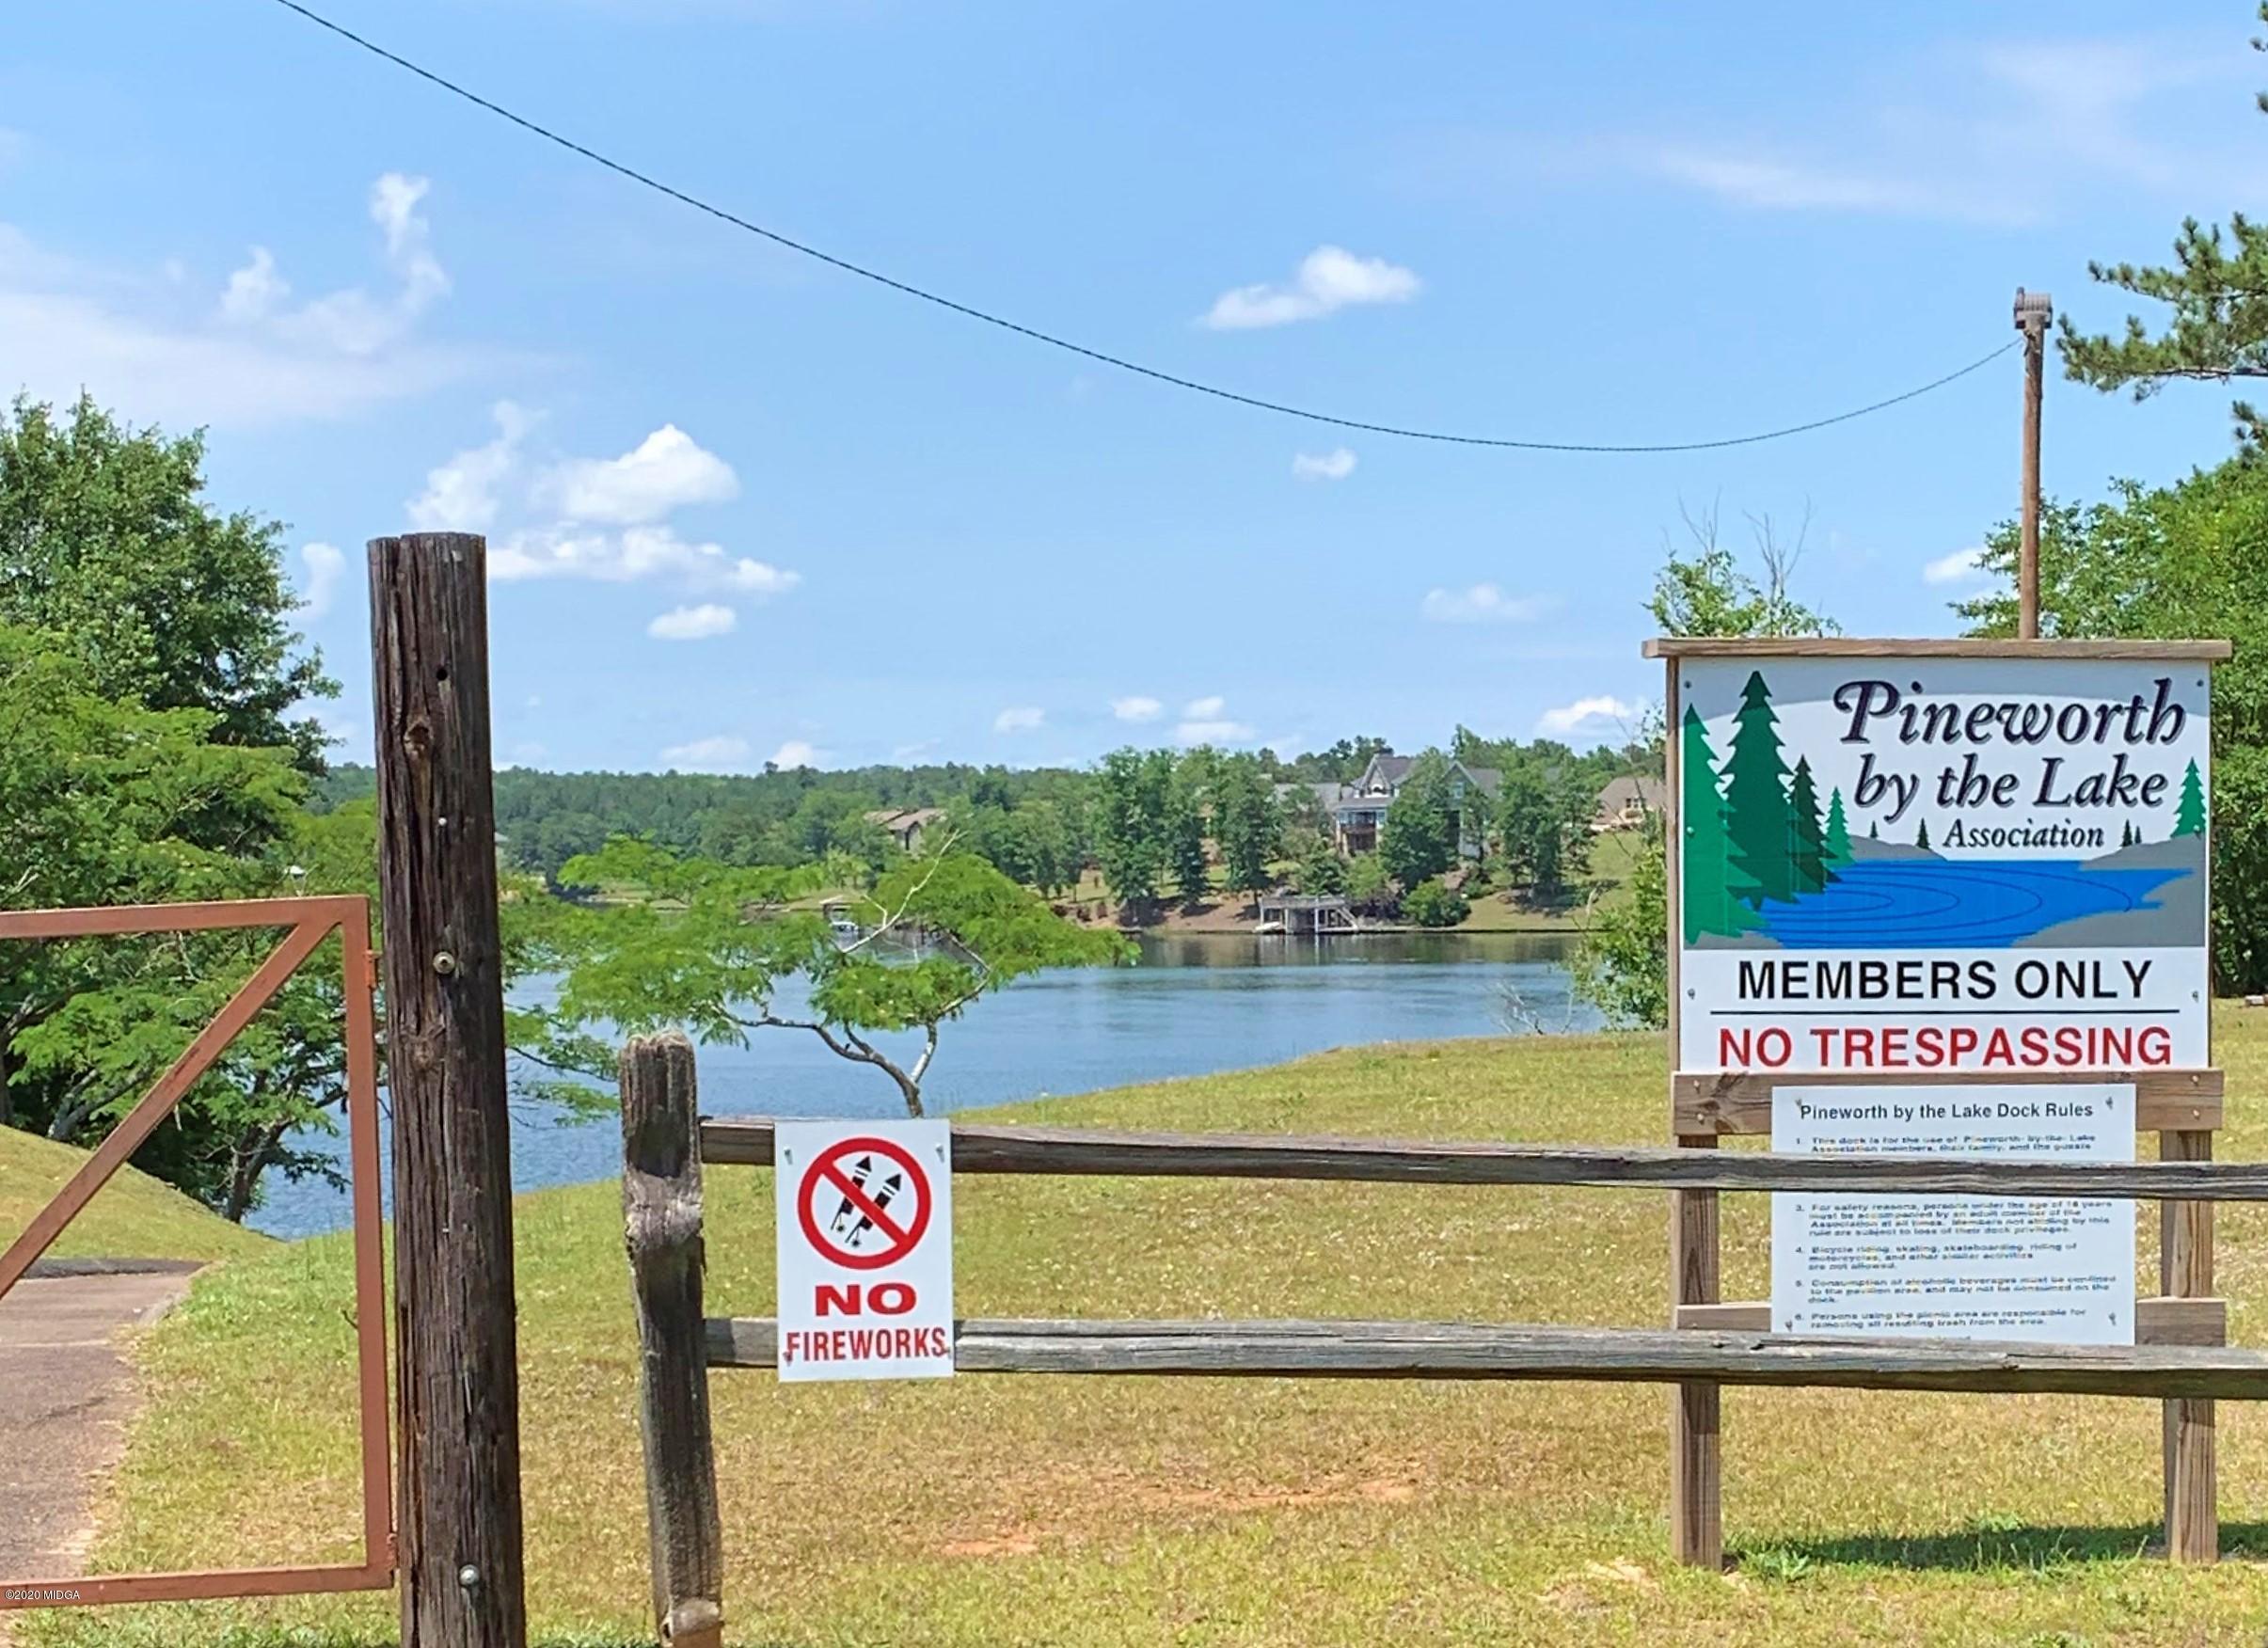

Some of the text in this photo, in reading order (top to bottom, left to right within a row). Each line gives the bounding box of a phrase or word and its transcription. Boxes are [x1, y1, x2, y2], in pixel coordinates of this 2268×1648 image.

[1832, 678, 2186, 746] Pineworth
[1854, 752, 2169, 824] by the Lake
[1943, 818, 2104, 848] Association
[1737, 960, 2152, 1000] MEMBERS ONLY
[1720, 1026, 2171, 1067] NO TRESPASSING
[1800, 1101, 2093, 1121] Pineworth by the Lake Dock Rules
[815, 1282, 916, 1317] NO
[786, 1326, 948, 1362] FIREWORKS
